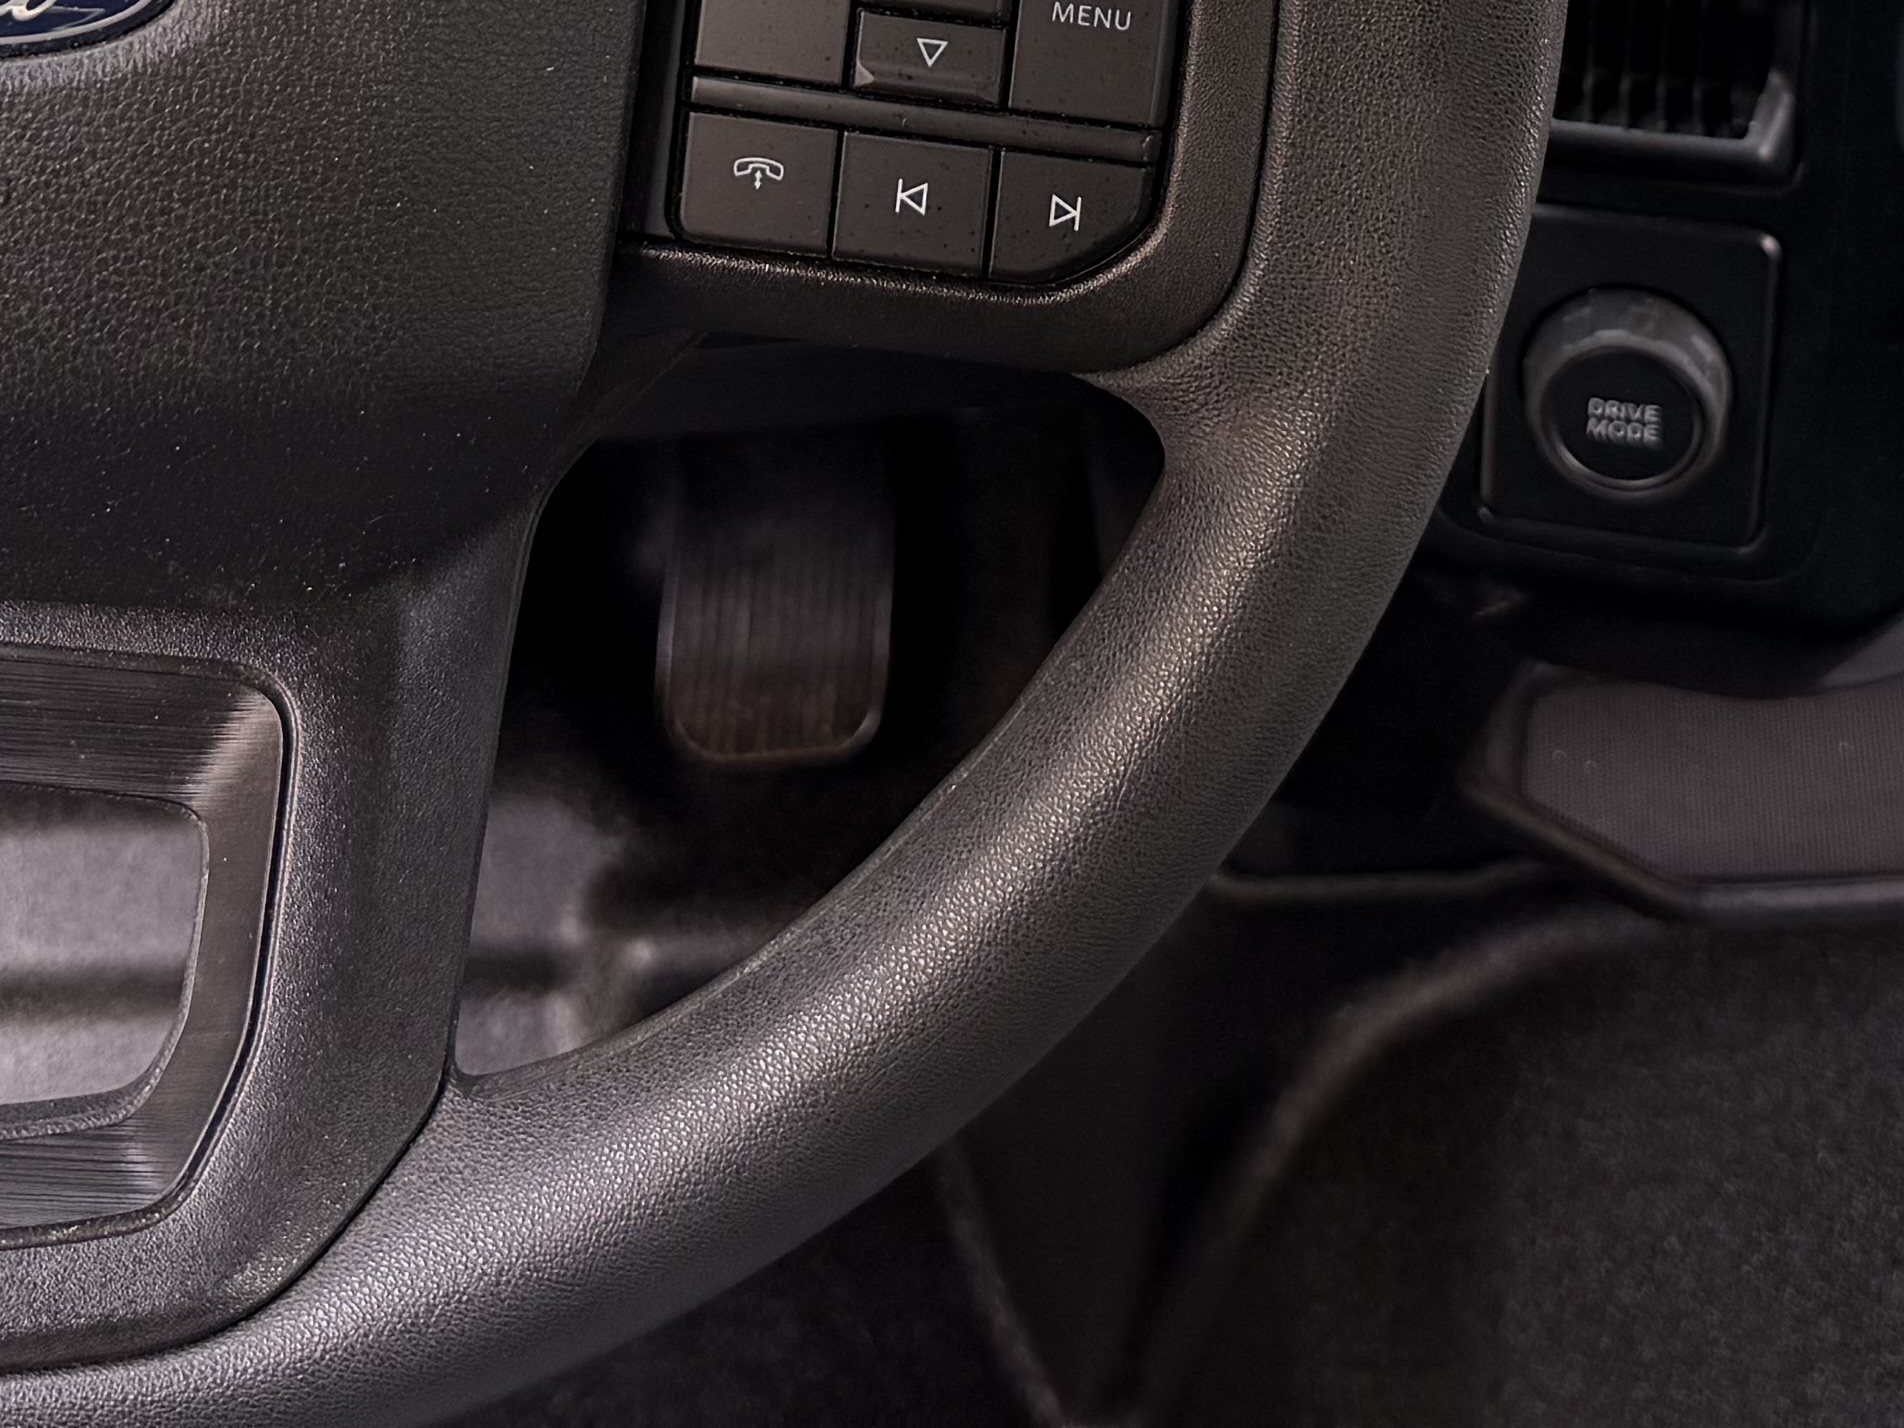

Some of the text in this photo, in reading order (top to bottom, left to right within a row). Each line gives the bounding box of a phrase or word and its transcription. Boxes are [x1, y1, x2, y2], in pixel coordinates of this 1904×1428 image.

[1052, 2, 1132, 32] MENU
[1587, 397, 1662, 423] DRIVE
[1586, 418, 1662, 444] MODE
